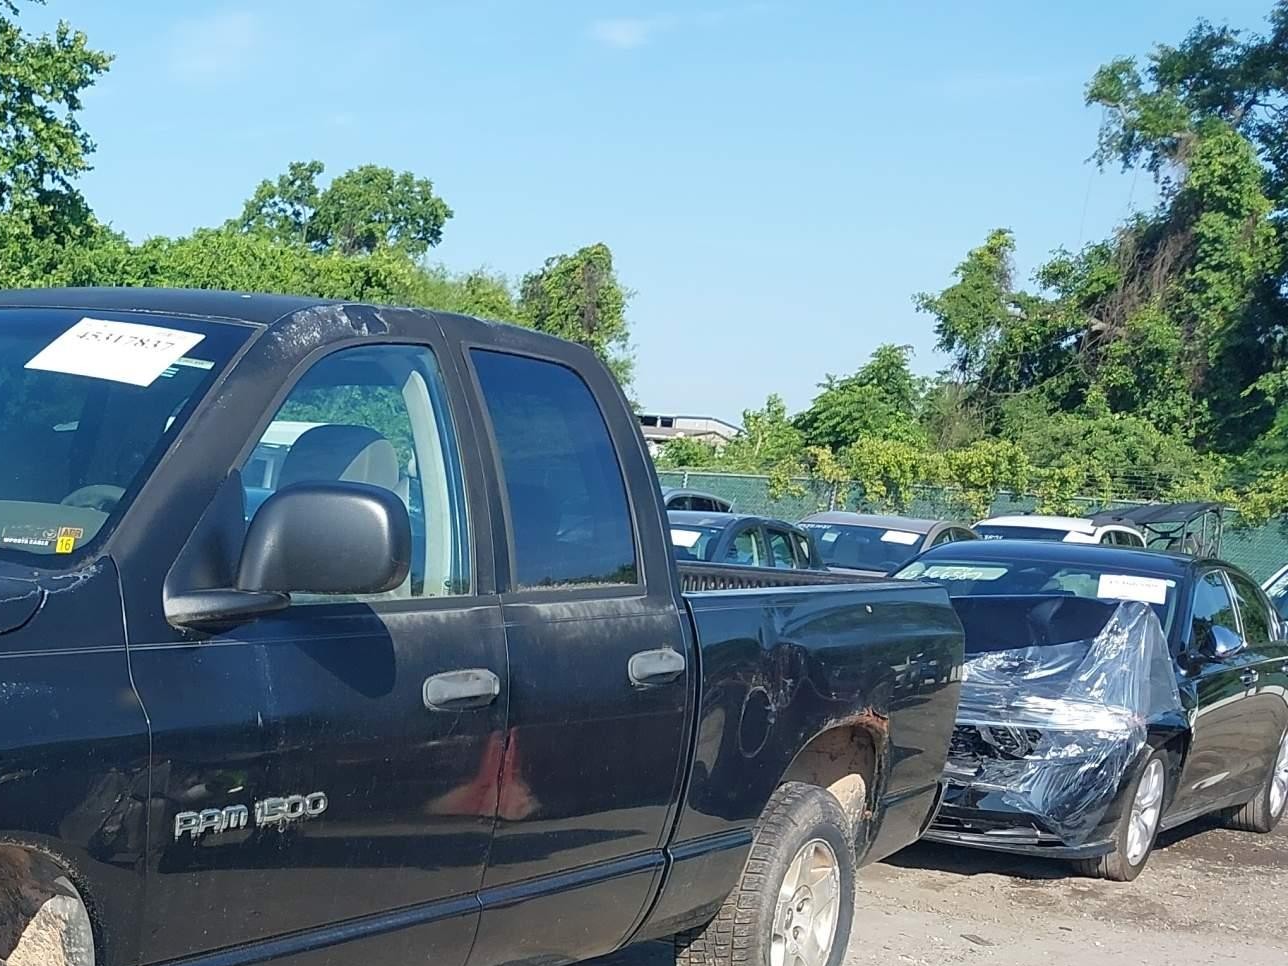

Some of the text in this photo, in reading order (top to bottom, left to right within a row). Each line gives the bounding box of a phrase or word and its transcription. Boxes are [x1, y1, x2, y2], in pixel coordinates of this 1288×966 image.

[75, 330, 177, 352] 45317837
[174, 791, 329, 840] RAM 1500
